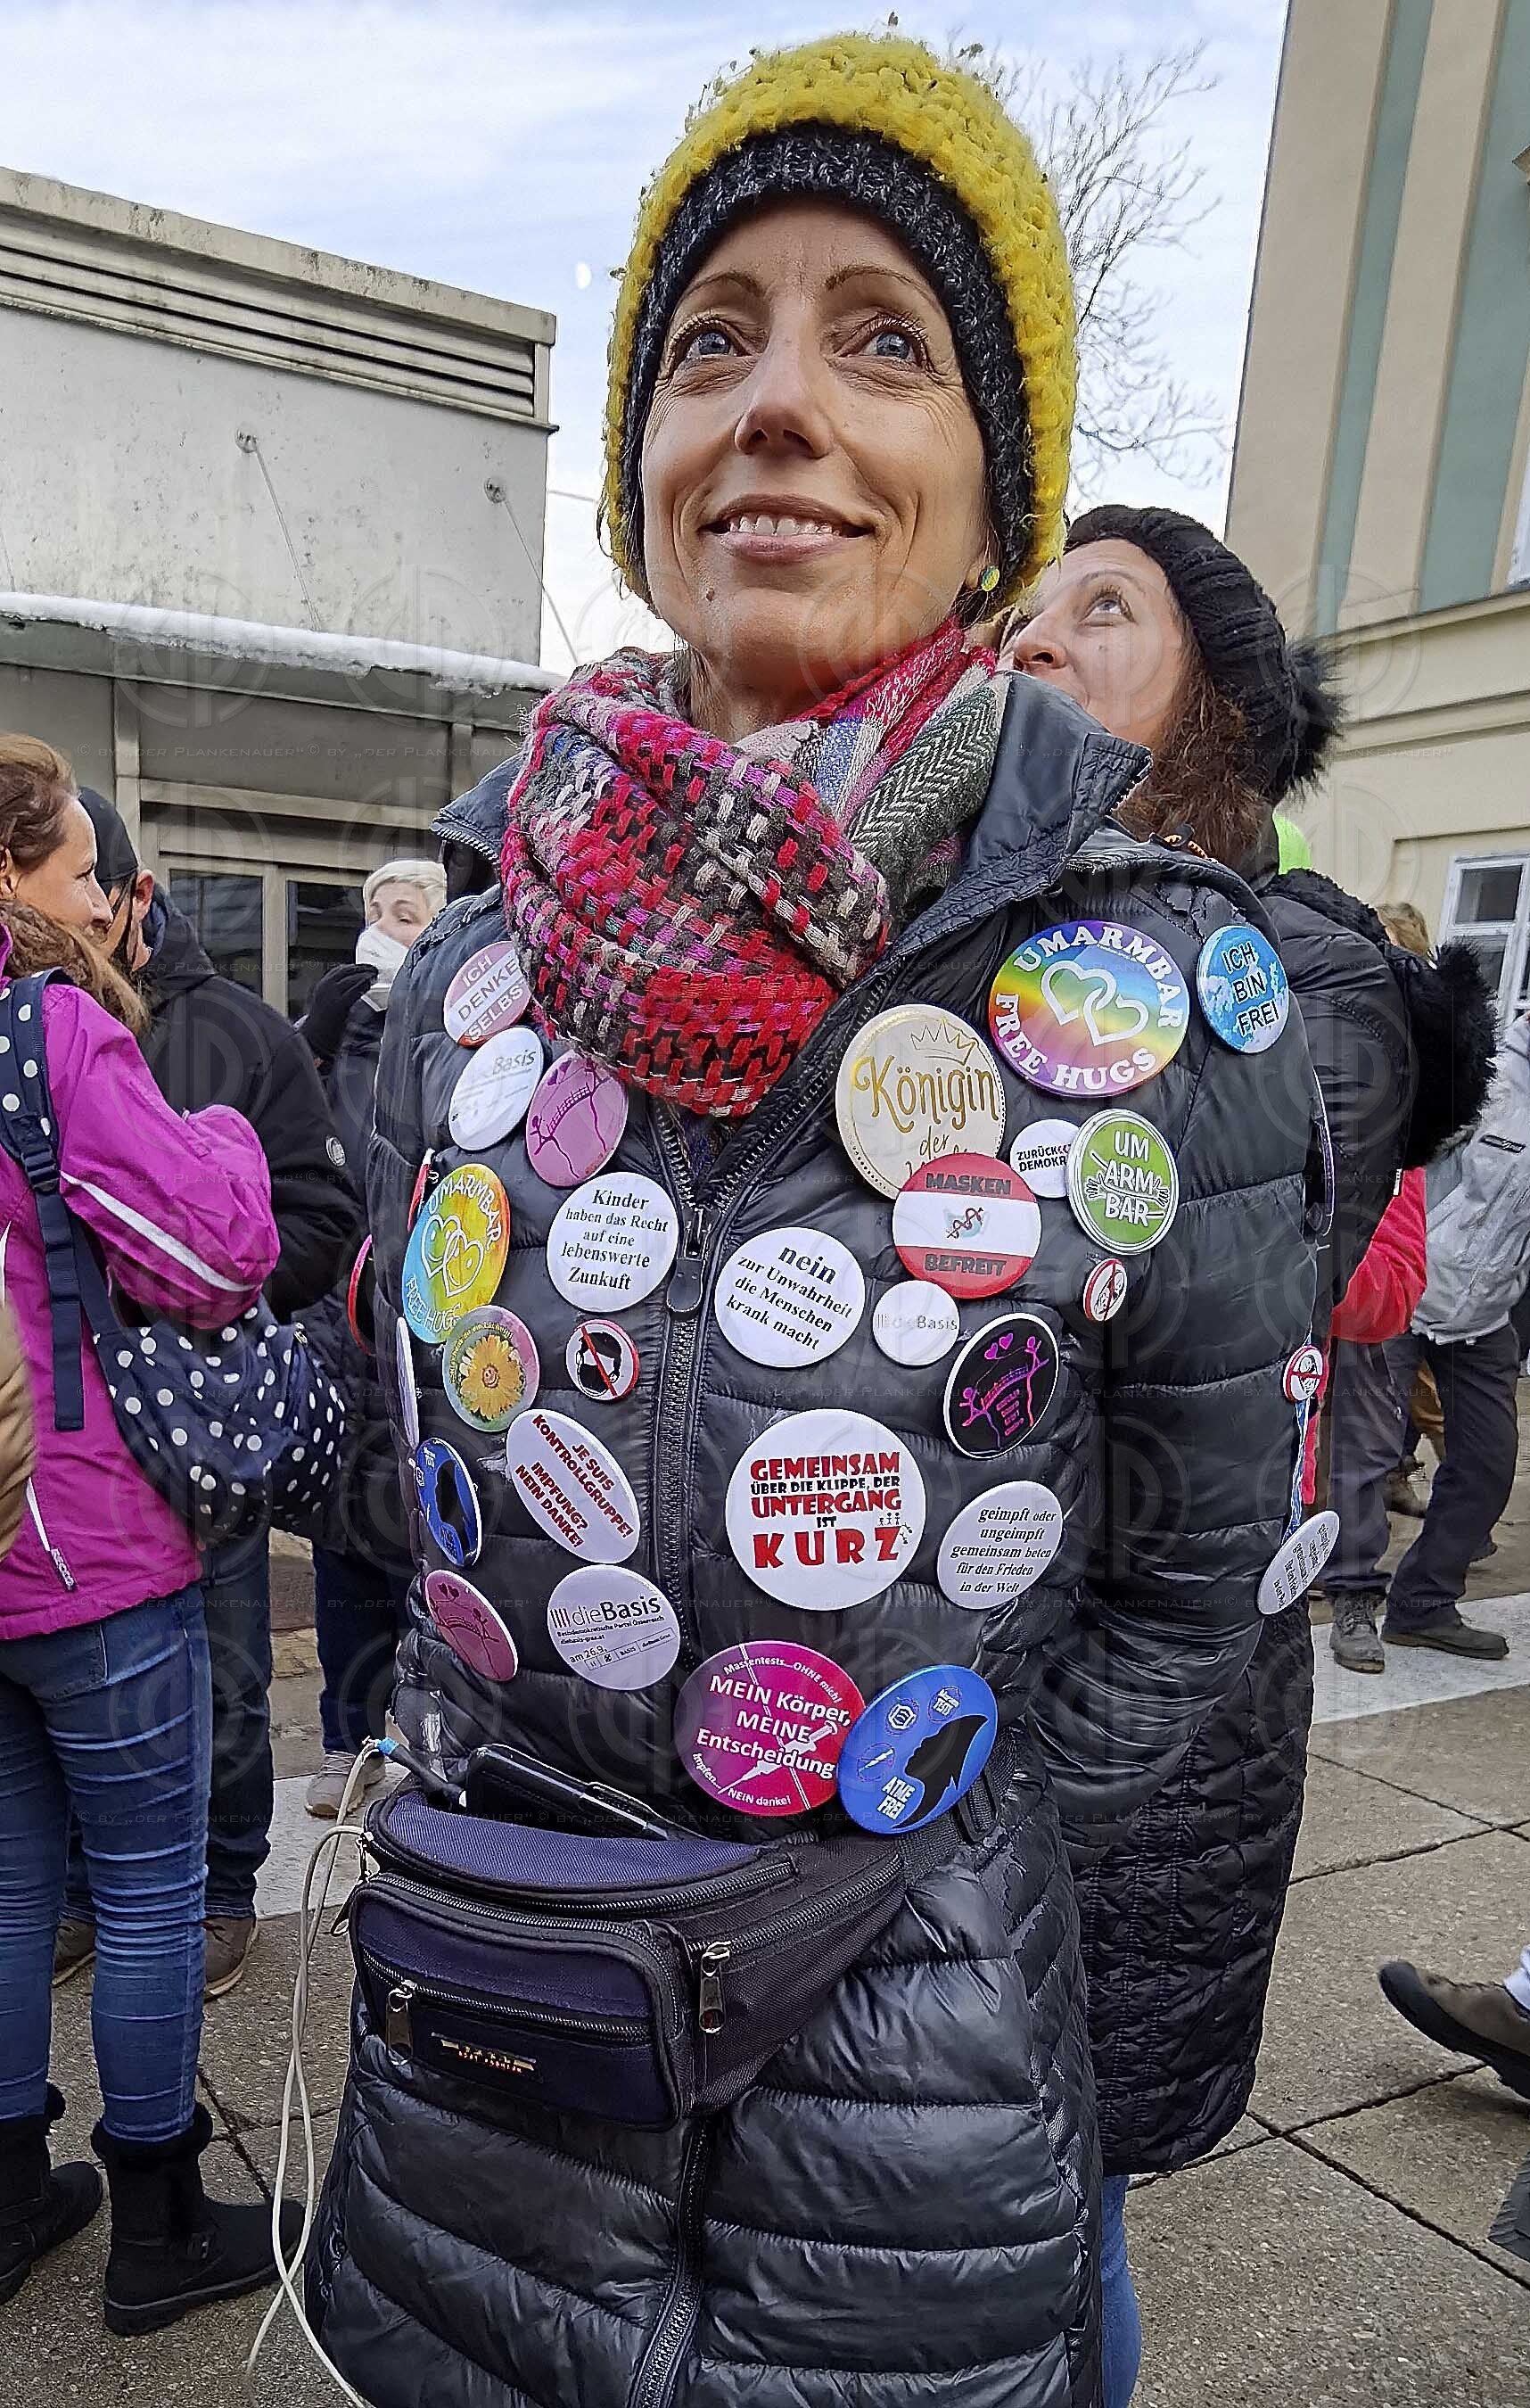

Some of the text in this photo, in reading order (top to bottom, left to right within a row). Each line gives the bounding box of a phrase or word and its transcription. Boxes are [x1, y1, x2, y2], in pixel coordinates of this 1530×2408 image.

[462, 955, 493, 987] ICH
[1222, 941, 1256, 973] ICH
[458, 958, 519, 1021] DENKE
[1014, 926, 1185, 1027] UMARMBAR
[1232, 971, 1266, 1002] BIN
[1238, 1000, 1279, 1036] FREI
[995, 993, 1156, 1090] FREE HUGS
[851, 1055, 999, 1134] Königin
[919, 1126, 950, 1160] der
[1115, 1131, 1149, 1161] UM
[926, 1173, 1011, 1194] MASKEN
[1105, 1159, 1154, 1194] ARM
[428, 1174, 501, 1251] UMARMBAR
[592, 1189, 650, 1210] Kinder
[1106, 1192, 1148, 1226] BAR
[565, 1208, 669, 1233] haben das Recht
[561, 1241, 650, 1268] lebenswerte
[583, 1230, 635, 1247] auf eine
[778, 1247, 836, 1284] nein
[925, 1254, 1007, 1276] BEFREIT
[406, 1276, 427, 1323] FREE
[737, 1257, 852, 1318] zur Unwahrheit
[735, 1277, 833, 1332] die Menschen
[726, 1294, 819, 1350] krank macht
[532, 1414, 634, 1538] KONTROLLGRUPPE!
[572, 1444, 614, 1491] JE SUIS
[750, 1452, 901, 1481] GEMEINSAM
[531, 1462, 588, 1530] IMPFUNG?
[751, 1476, 901, 1496] ÜBER DIE KLIPPE, DER
[515, 1464, 584, 1547] NEIN DANKE!
[751, 1489, 901, 1519] UNTERGANG
[978, 1506, 1057, 1524] geimpft oder
[817, 1516, 837, 1529] IST
[980, 1527, 1045, 1543] ungeimpft
[753, 1526, 901, 1569] KURZ
[950, 1545, 1052, 1558] gemeinsam beten
[956, 1562, 1033, 1576] für den Frieden
[959, 1582, 1020, 1593] in der Welt
[572, 1596, 661, 1626] dieBasis
[570, 1645, 608, 1663] am 26.9.
[710, 1675, 851, 1726] MEIN Körper,
[736, 1711, 812, 1743] MEINE
[696, 1728, 835, 1779] Entscheidung
[728, 1787, 753, 1803] NEIN
